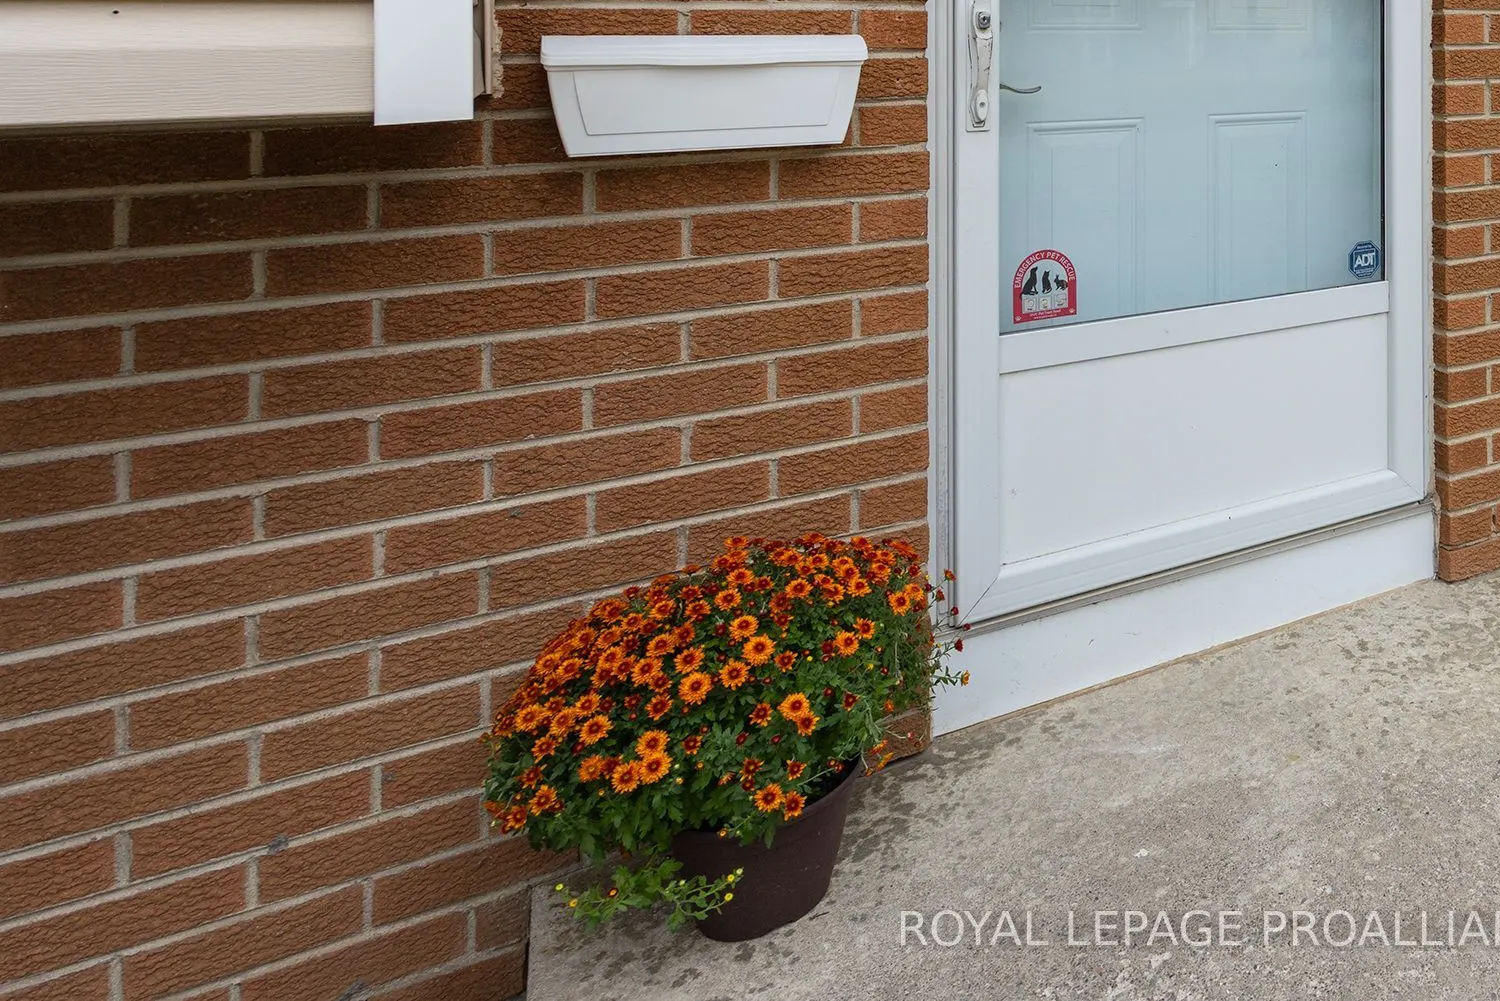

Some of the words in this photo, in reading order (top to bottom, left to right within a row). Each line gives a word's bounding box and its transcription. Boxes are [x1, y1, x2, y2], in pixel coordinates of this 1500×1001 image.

[1014, 252, 1045, 288] EMERGENCY
[1046, 251, 1060, 259] PET
[1059, 257, 1075, 280] RESCUE
[1354, 252, 1375, 268] ADT
